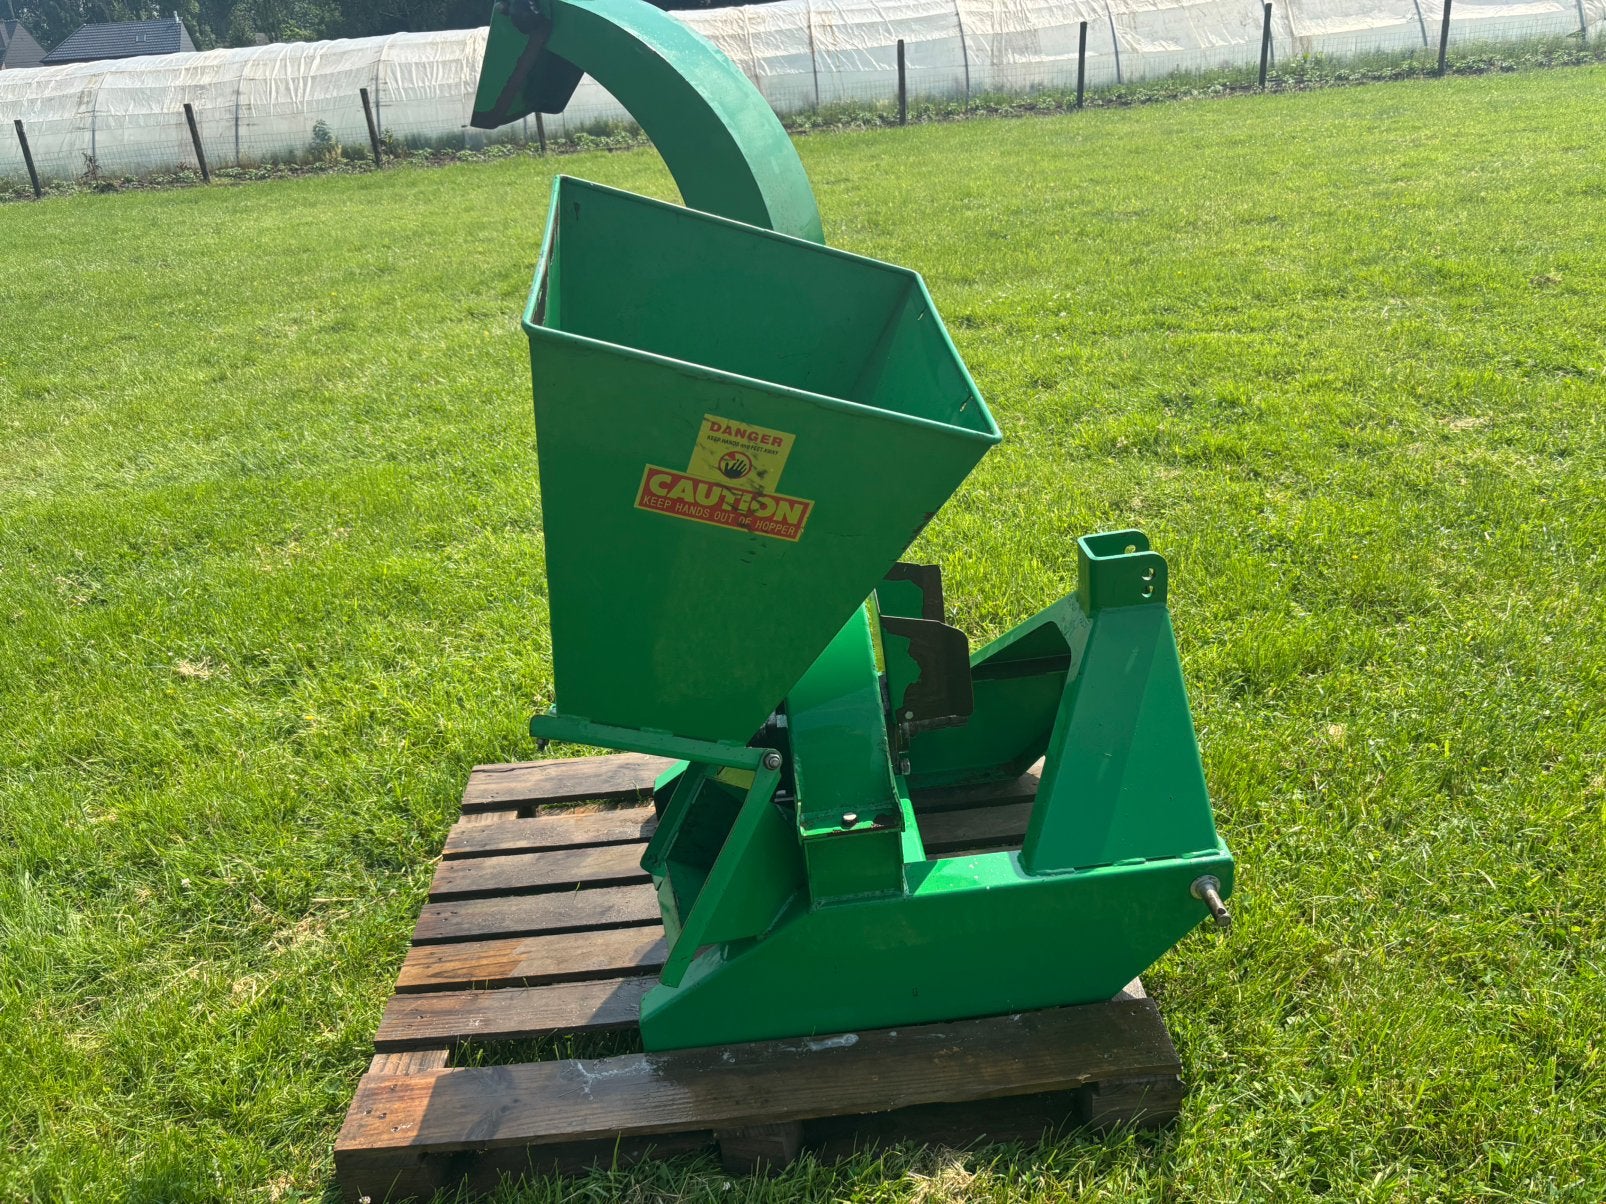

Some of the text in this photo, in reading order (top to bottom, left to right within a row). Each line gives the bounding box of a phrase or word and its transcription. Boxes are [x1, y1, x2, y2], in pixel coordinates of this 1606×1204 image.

[706, 434, 721, 443] KEEP
[751, 444, 763, 453] FEET
[709, 421, 783, 447] DANGER
[643, 495, 796, 536] KEEP HANDS OUT OF HOPPER
[649, 473, 804, 525] CAUTION
